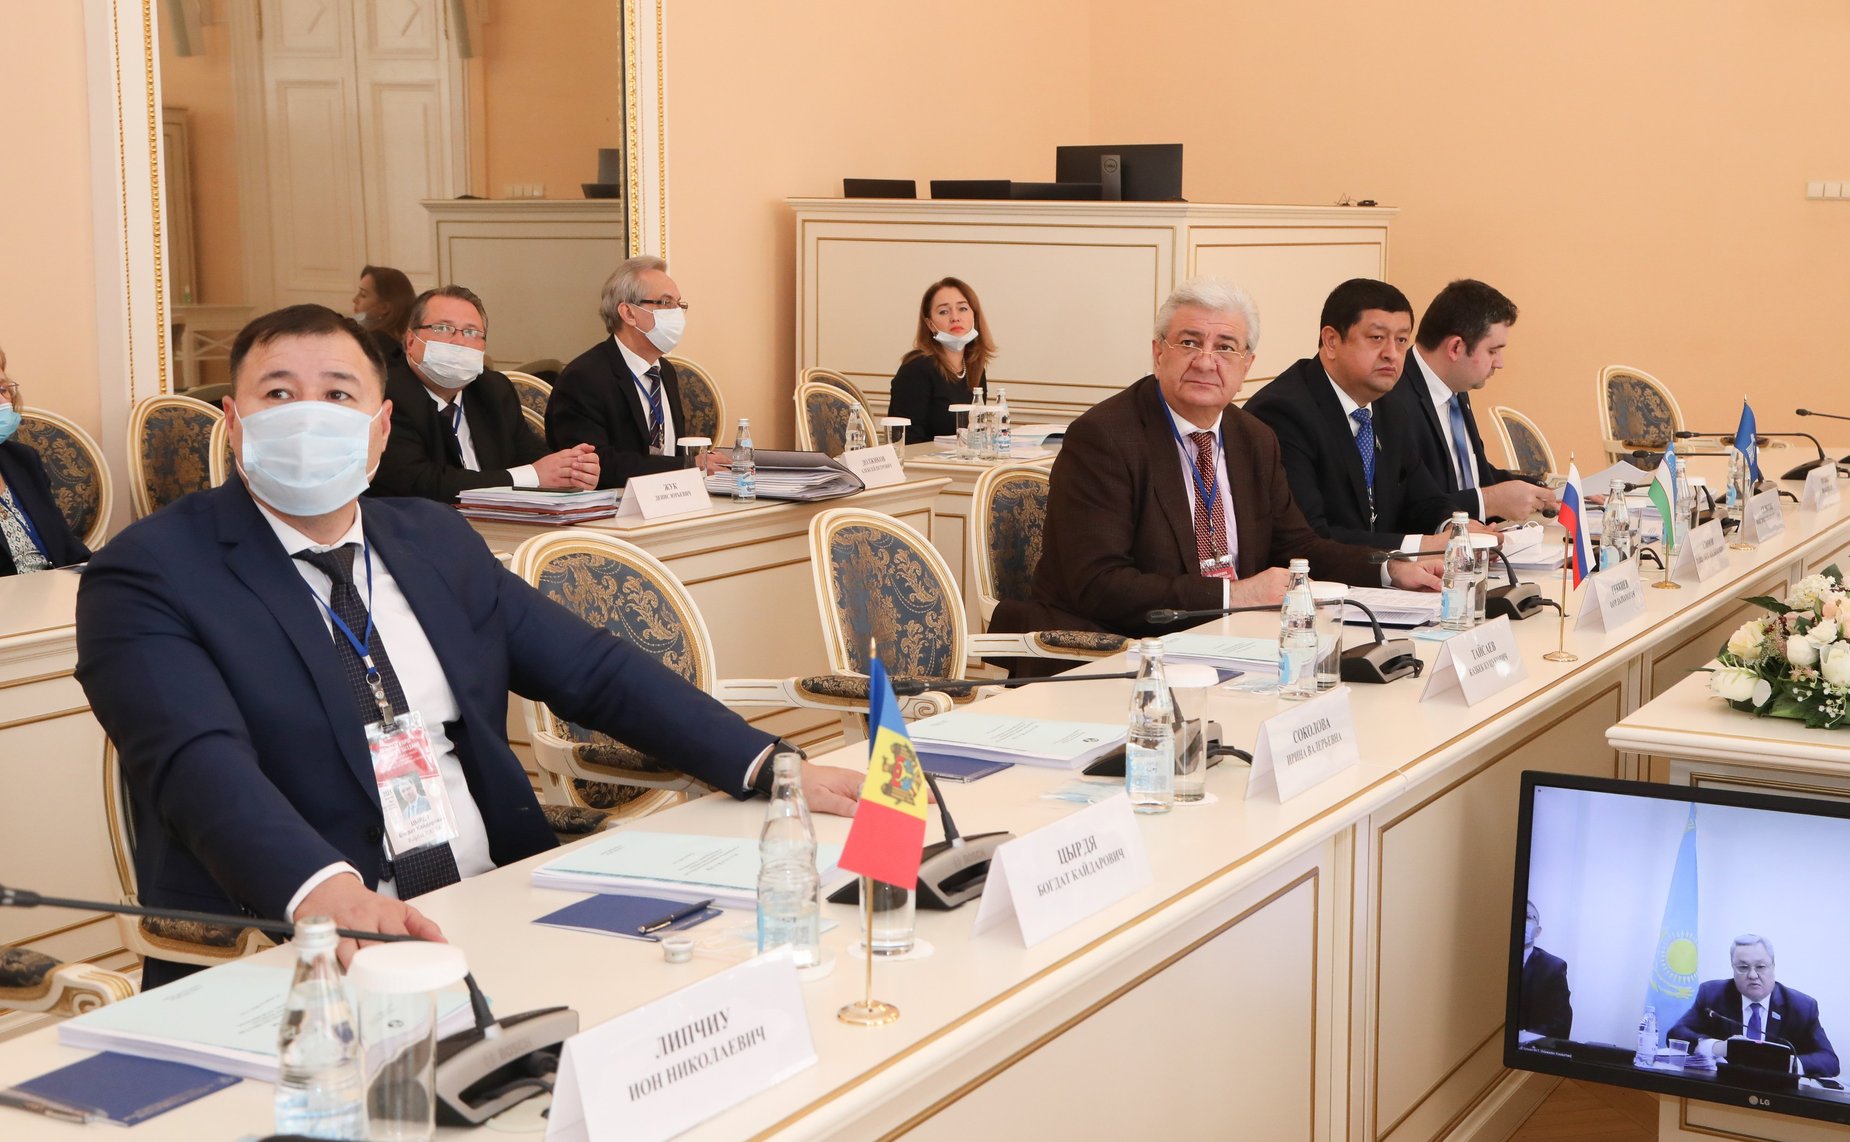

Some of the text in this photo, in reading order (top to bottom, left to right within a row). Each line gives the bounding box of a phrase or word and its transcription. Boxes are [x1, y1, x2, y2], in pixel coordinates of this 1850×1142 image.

[663, 482, 678, 491] ЖУК
[1471, 641, 1497, 660] ТАЙСАЕВ
[1293, 718, 1331, 744] СОКОЛОВА
[1286, 748, 1307, 766] ИРИНА
[1057, 835, 1098, 865] ЦЫРДЯ
[1037, 848, 1126, 897] БОГДАТ КАЙДАРОВИЧ
[655, 1007, 730, 1059] ЛИПЧИУ
[628, 1026, 766, 1101] ИОН НИКОЛАЕВИЧ
[1759, 1098, 1770, 1106] LG
